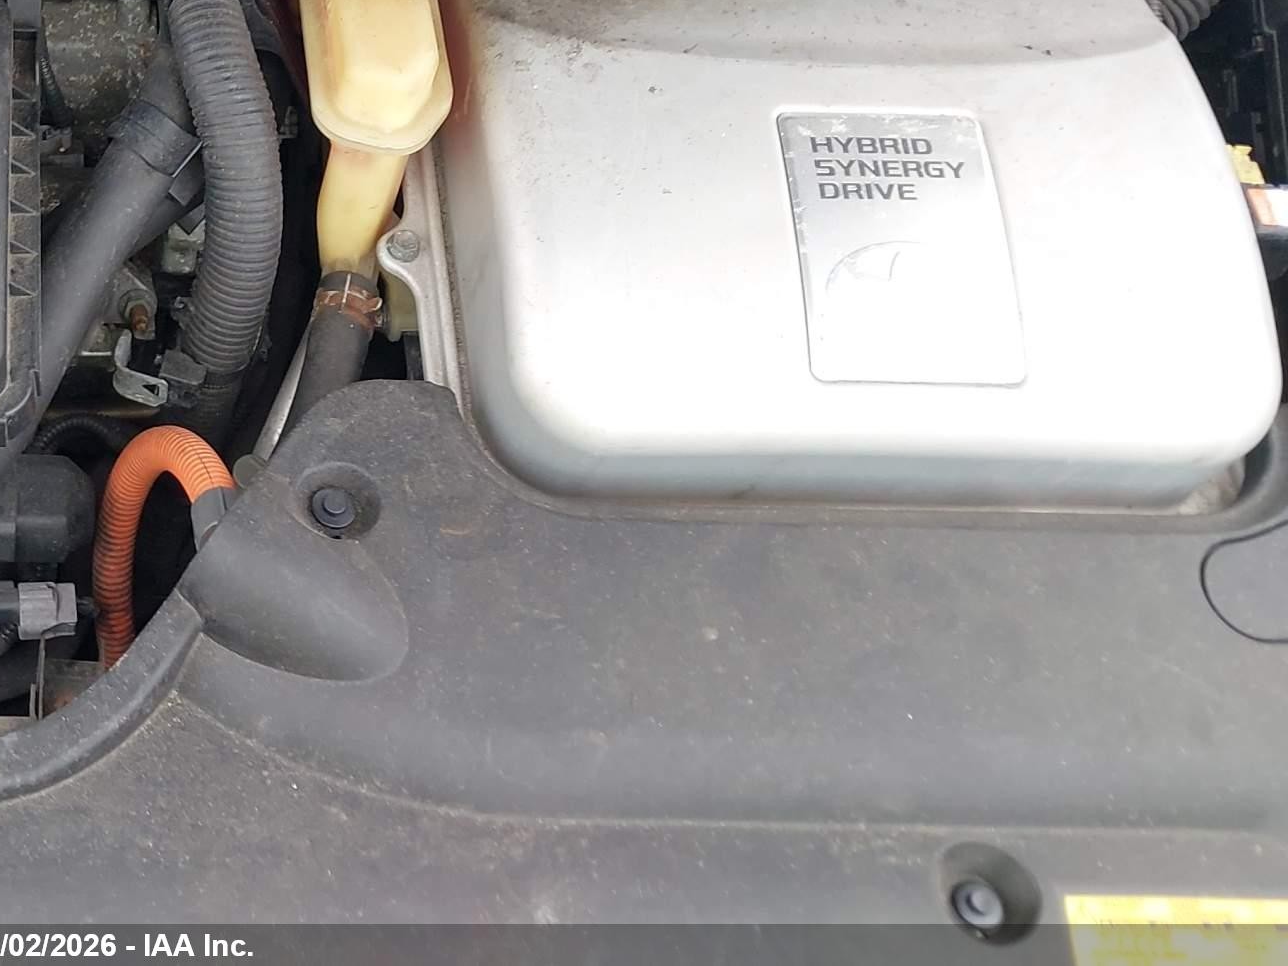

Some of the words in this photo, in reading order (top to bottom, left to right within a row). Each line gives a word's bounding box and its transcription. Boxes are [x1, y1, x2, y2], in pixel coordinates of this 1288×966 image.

[810, 136, 933, 155] HYBRID
[814, 159, 964, 178] SYNERGY
[818, 183, 918, 200] DRIVE
